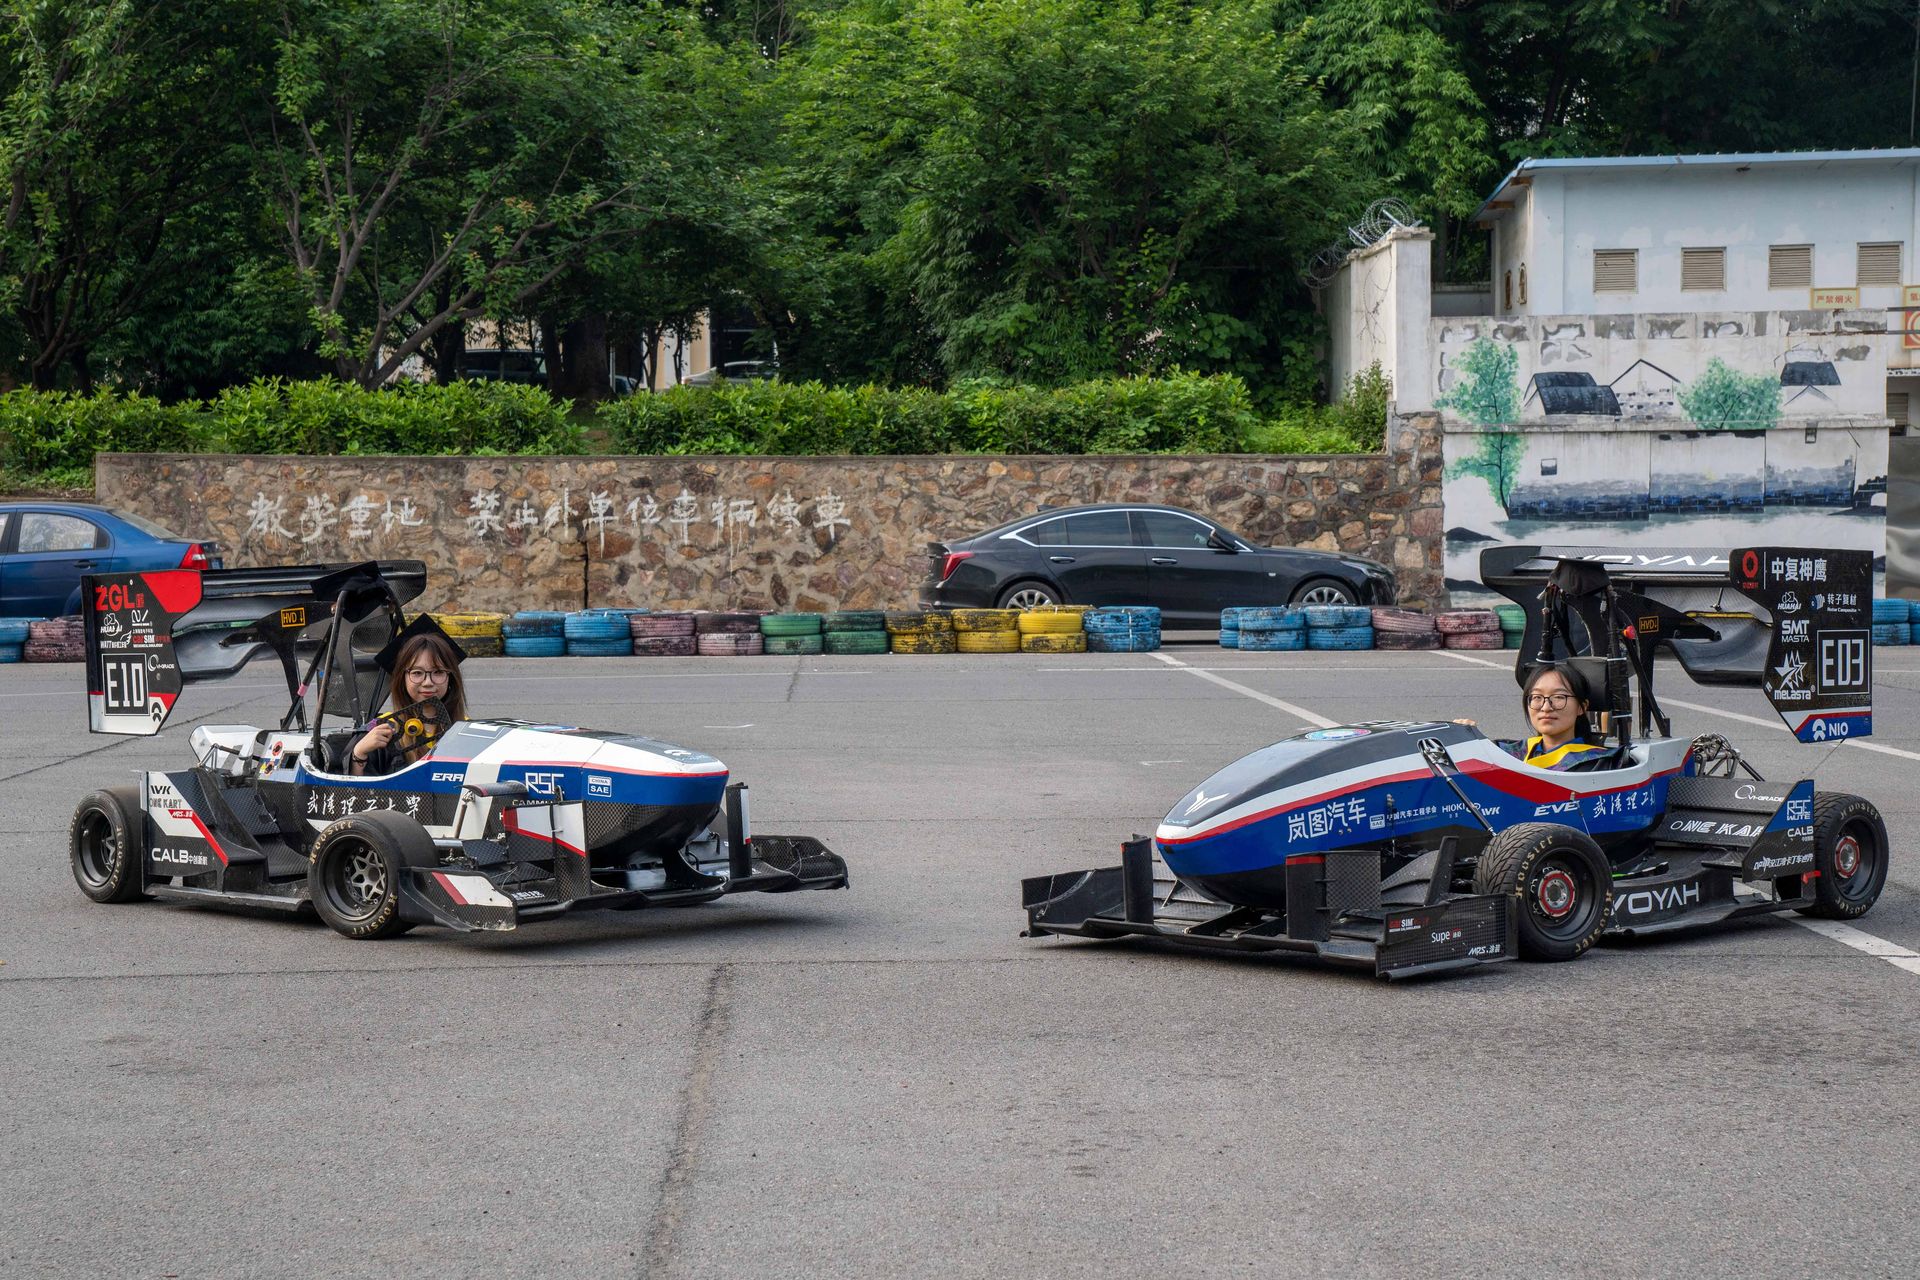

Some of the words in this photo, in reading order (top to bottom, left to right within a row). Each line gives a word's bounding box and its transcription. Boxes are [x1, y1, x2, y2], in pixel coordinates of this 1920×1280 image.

[1771, 557, 1828, 582] 中复神鹰
[1781, 620, 1809, 634] SMT
[1781, 635, 1810, 643] MASTA
[1829, 722, 1849, 736] NIO
[590, 785, 609, 794] SAE
[1288, 797, 1366, 843] 岚图汽车
[1715, 823, 1764, 837] KAR
[1787, 826, 1814, 837] CALB
[151, 848, 189, 863] CALB
